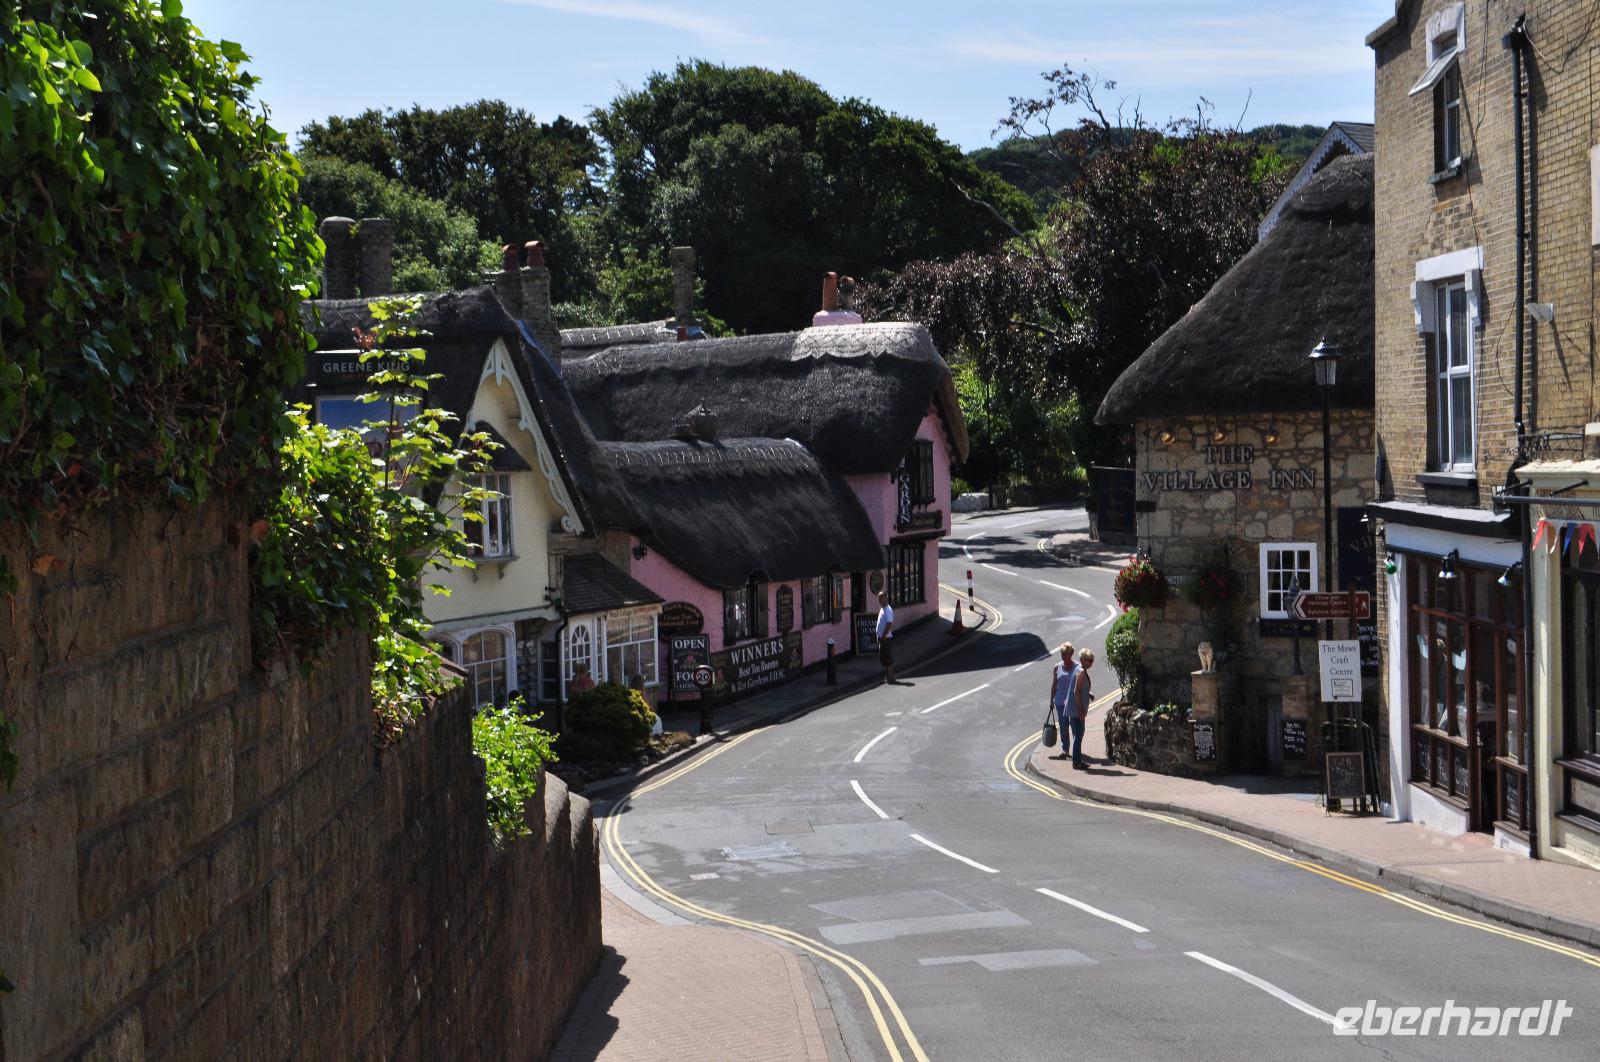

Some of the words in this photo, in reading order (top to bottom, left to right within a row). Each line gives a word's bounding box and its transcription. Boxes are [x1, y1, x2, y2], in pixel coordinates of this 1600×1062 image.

[322, 362, 374, 373] GREENE
[377, 361, 411, 372] KING
[1203, 445, 1255, 464] THE
[1143, 470, 1252, 491] VILLAGE
[1269, 469, 1316, 489] INN
[899, 474, 912, 525] GARDEN
[674, 639, 705, 649] OPEN
[1322, 644, 1337, 653] The
[1337, 644, 1357, 653] Mews
[730, 638, 784, 665] WINNERS
[1330, 655, 1350, 665] Craft
[697, 672, 709, 681] 20
[1330, 667, 1354, 677] Centre
